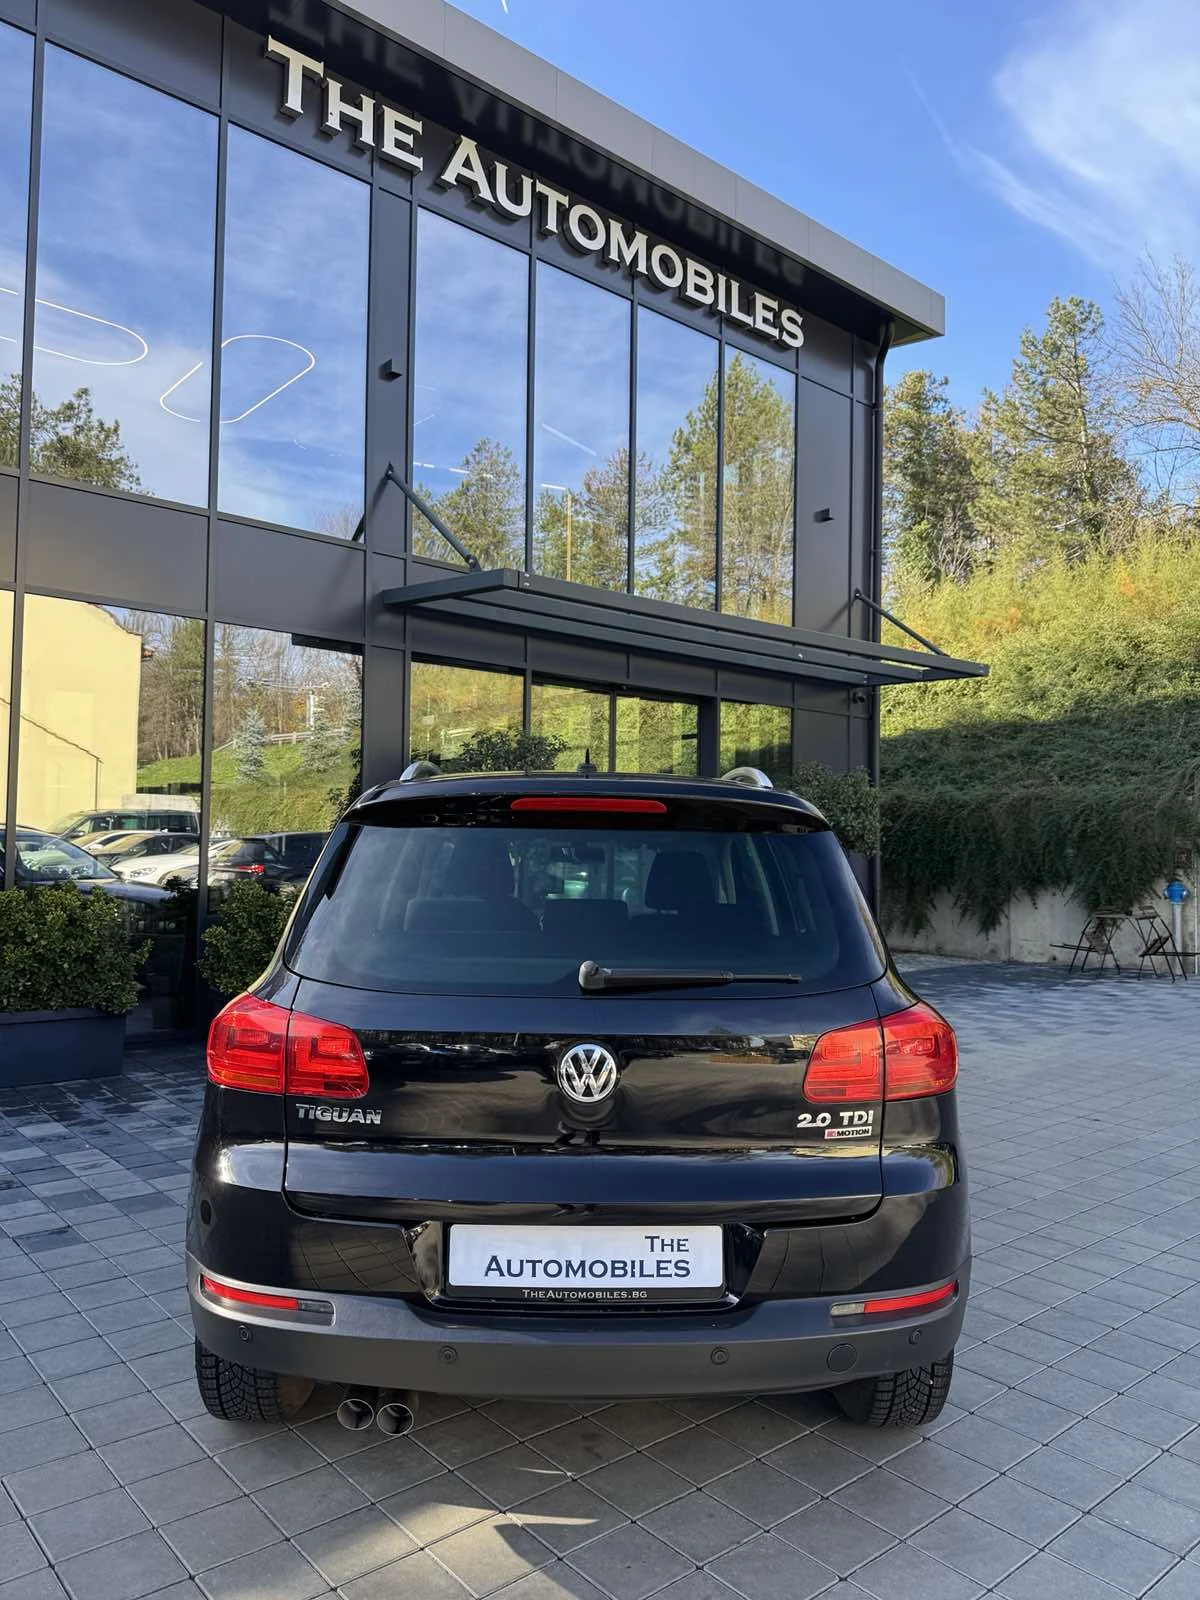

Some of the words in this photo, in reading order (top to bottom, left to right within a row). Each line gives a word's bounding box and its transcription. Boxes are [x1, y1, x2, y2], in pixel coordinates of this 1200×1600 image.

[267, 35, 424, 171] THE
[440, 135, 805, 348] AUTOMOBILES
[560, 1044, 617, 1103] VW
[295, 1103, 383, 1125] TIGUAN
[839, 1110, 874, 1126] TDI
[644, 1235, 690, 1253] THE
[484, 1255, 691, 1279] AUTOMOBILES
